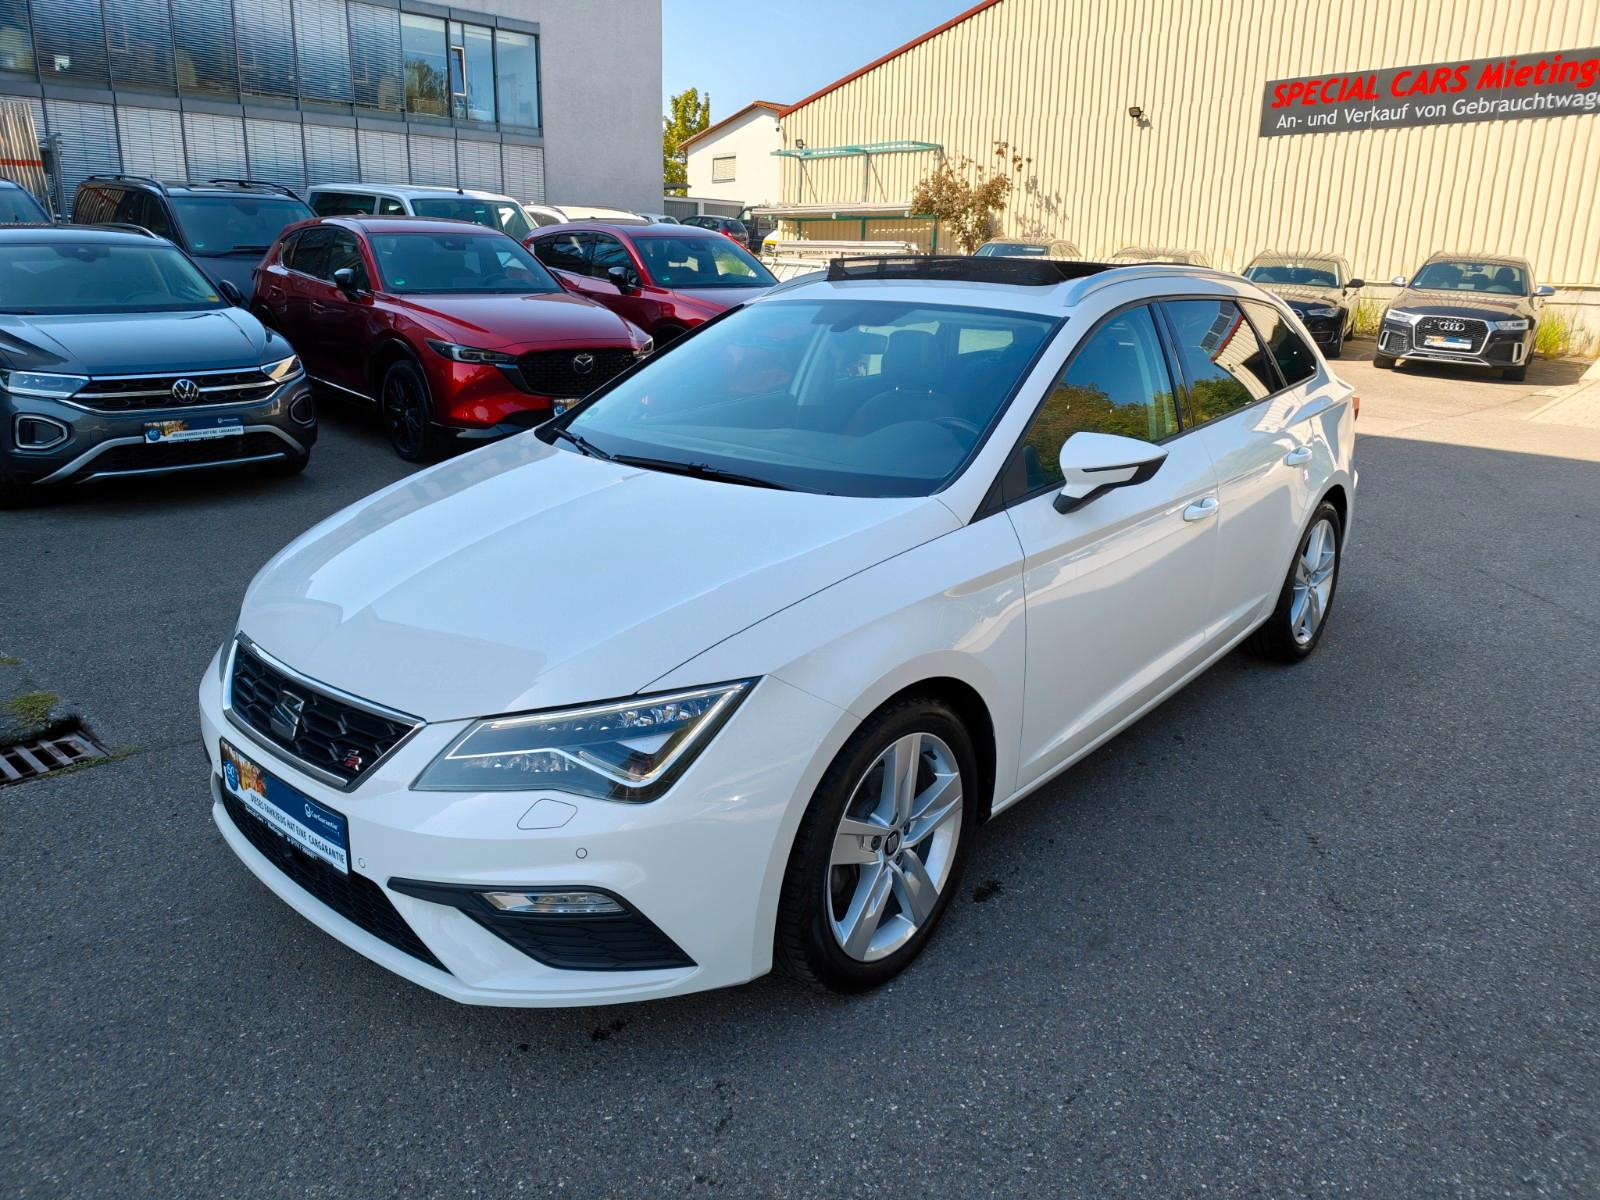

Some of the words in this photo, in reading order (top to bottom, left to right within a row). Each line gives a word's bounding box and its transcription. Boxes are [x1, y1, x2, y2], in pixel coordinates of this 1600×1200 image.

[1271, 74, 1380, 108] SPECIAL
[1391, 65, 1470, 97] CARS
[1474, 54, 1600, 90] Mieting
[1276, 114, 1302, 129] An-
[1308, 109, 1337, 126] und
[1345, 104, 1410, 124] Verkauf
[1415, 104, 1446, 118] von
